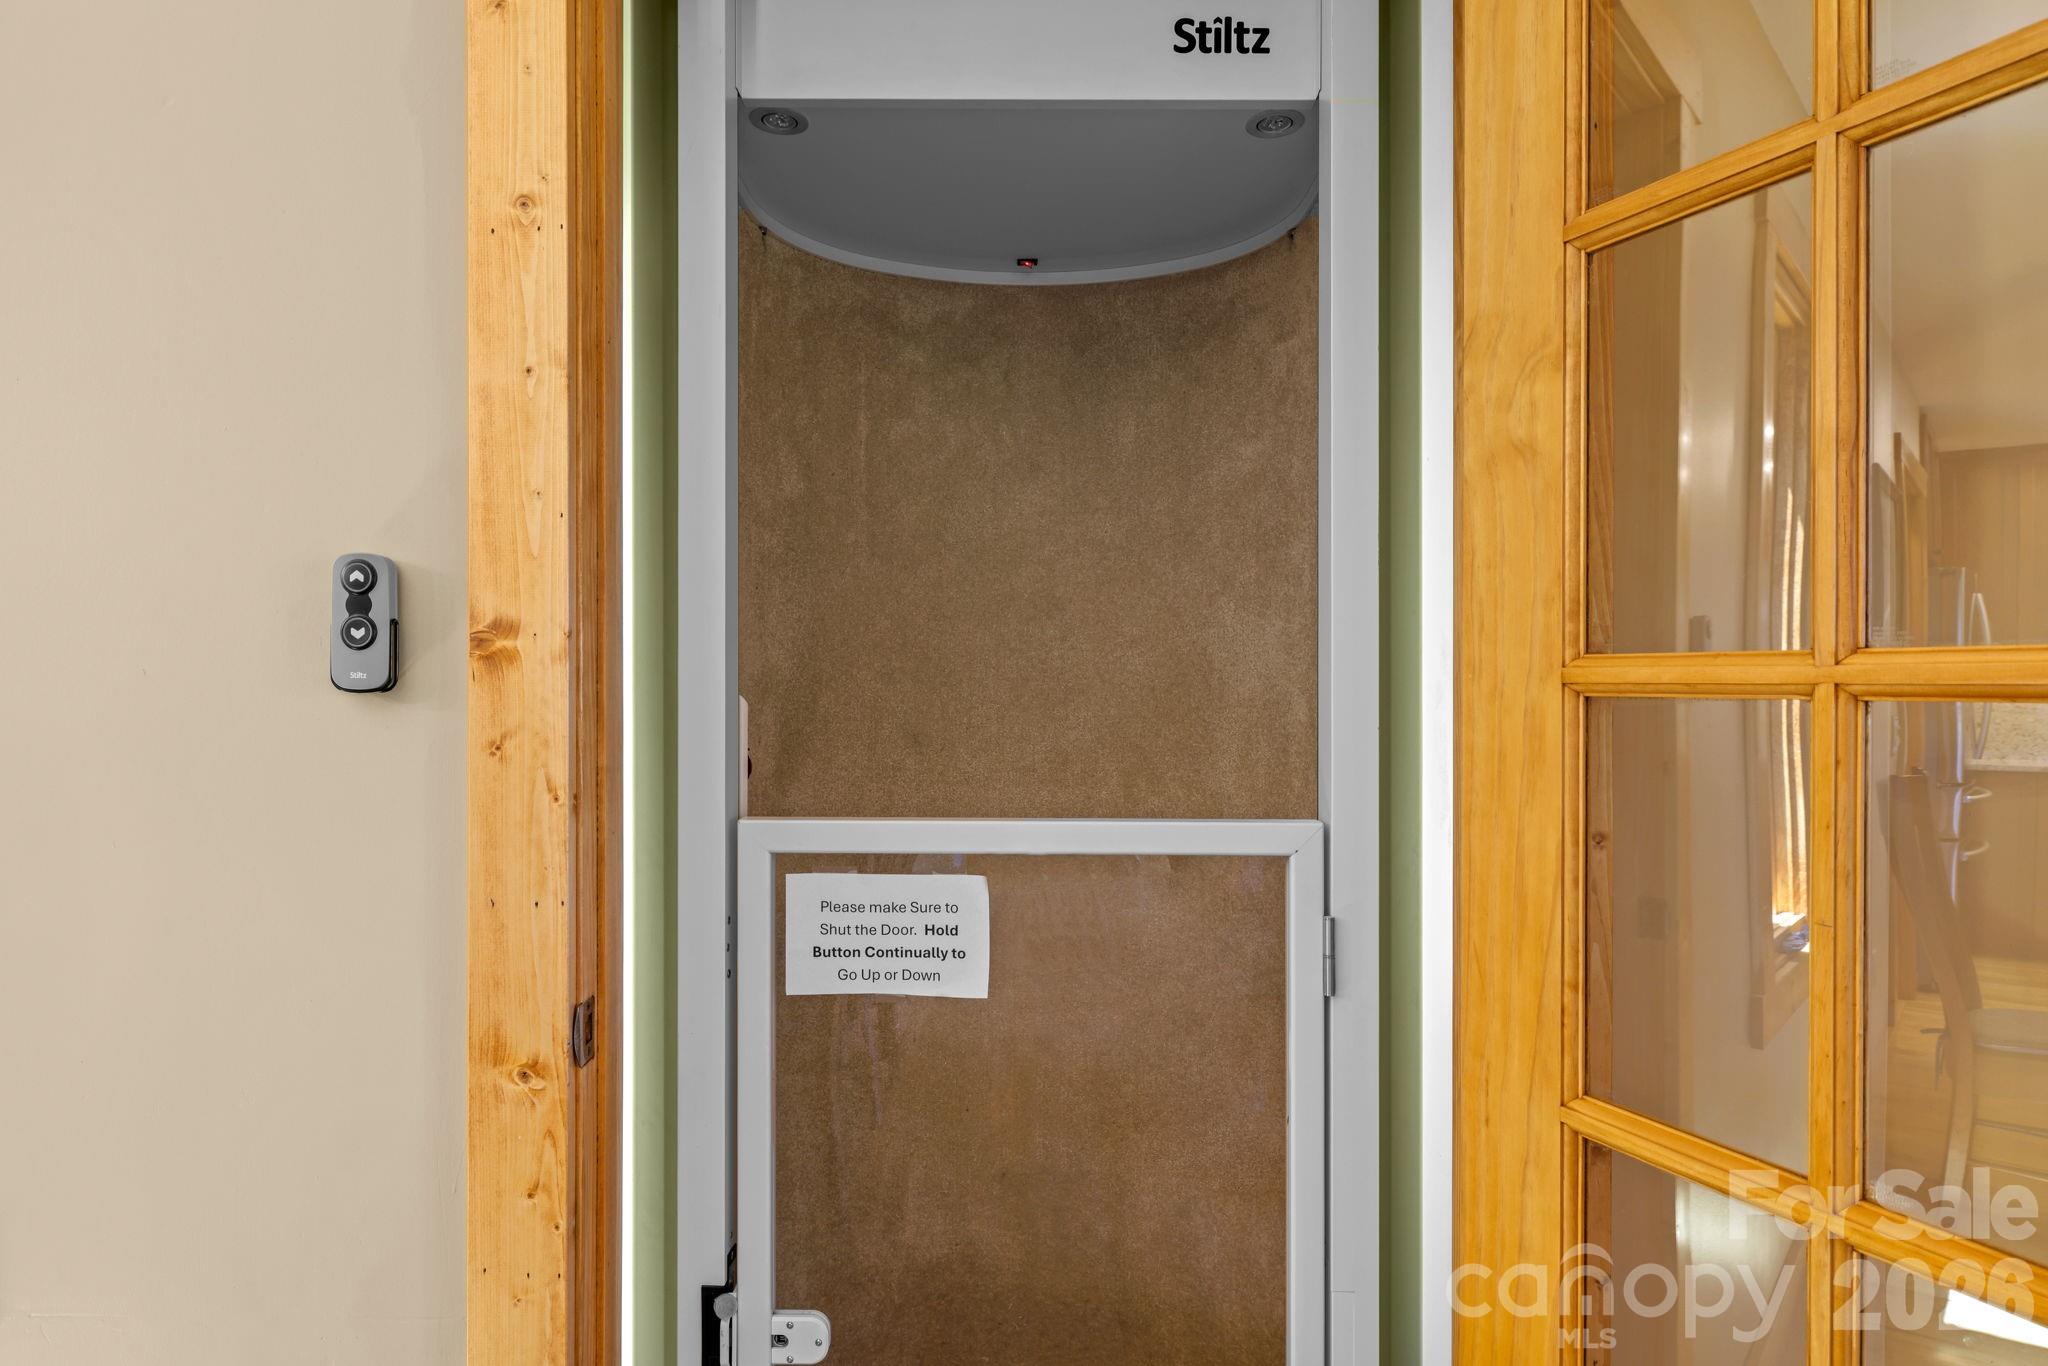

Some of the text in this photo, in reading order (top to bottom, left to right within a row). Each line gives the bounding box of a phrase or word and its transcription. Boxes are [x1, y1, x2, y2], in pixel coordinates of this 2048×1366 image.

[820, 900, 959, 914] Please make Sure to
[819, 923, 959, 936] Shut the Door. Hold
[813, 946, 966, 961] Button Continually to
[837, 969, 941, 982] Go Up or Down
